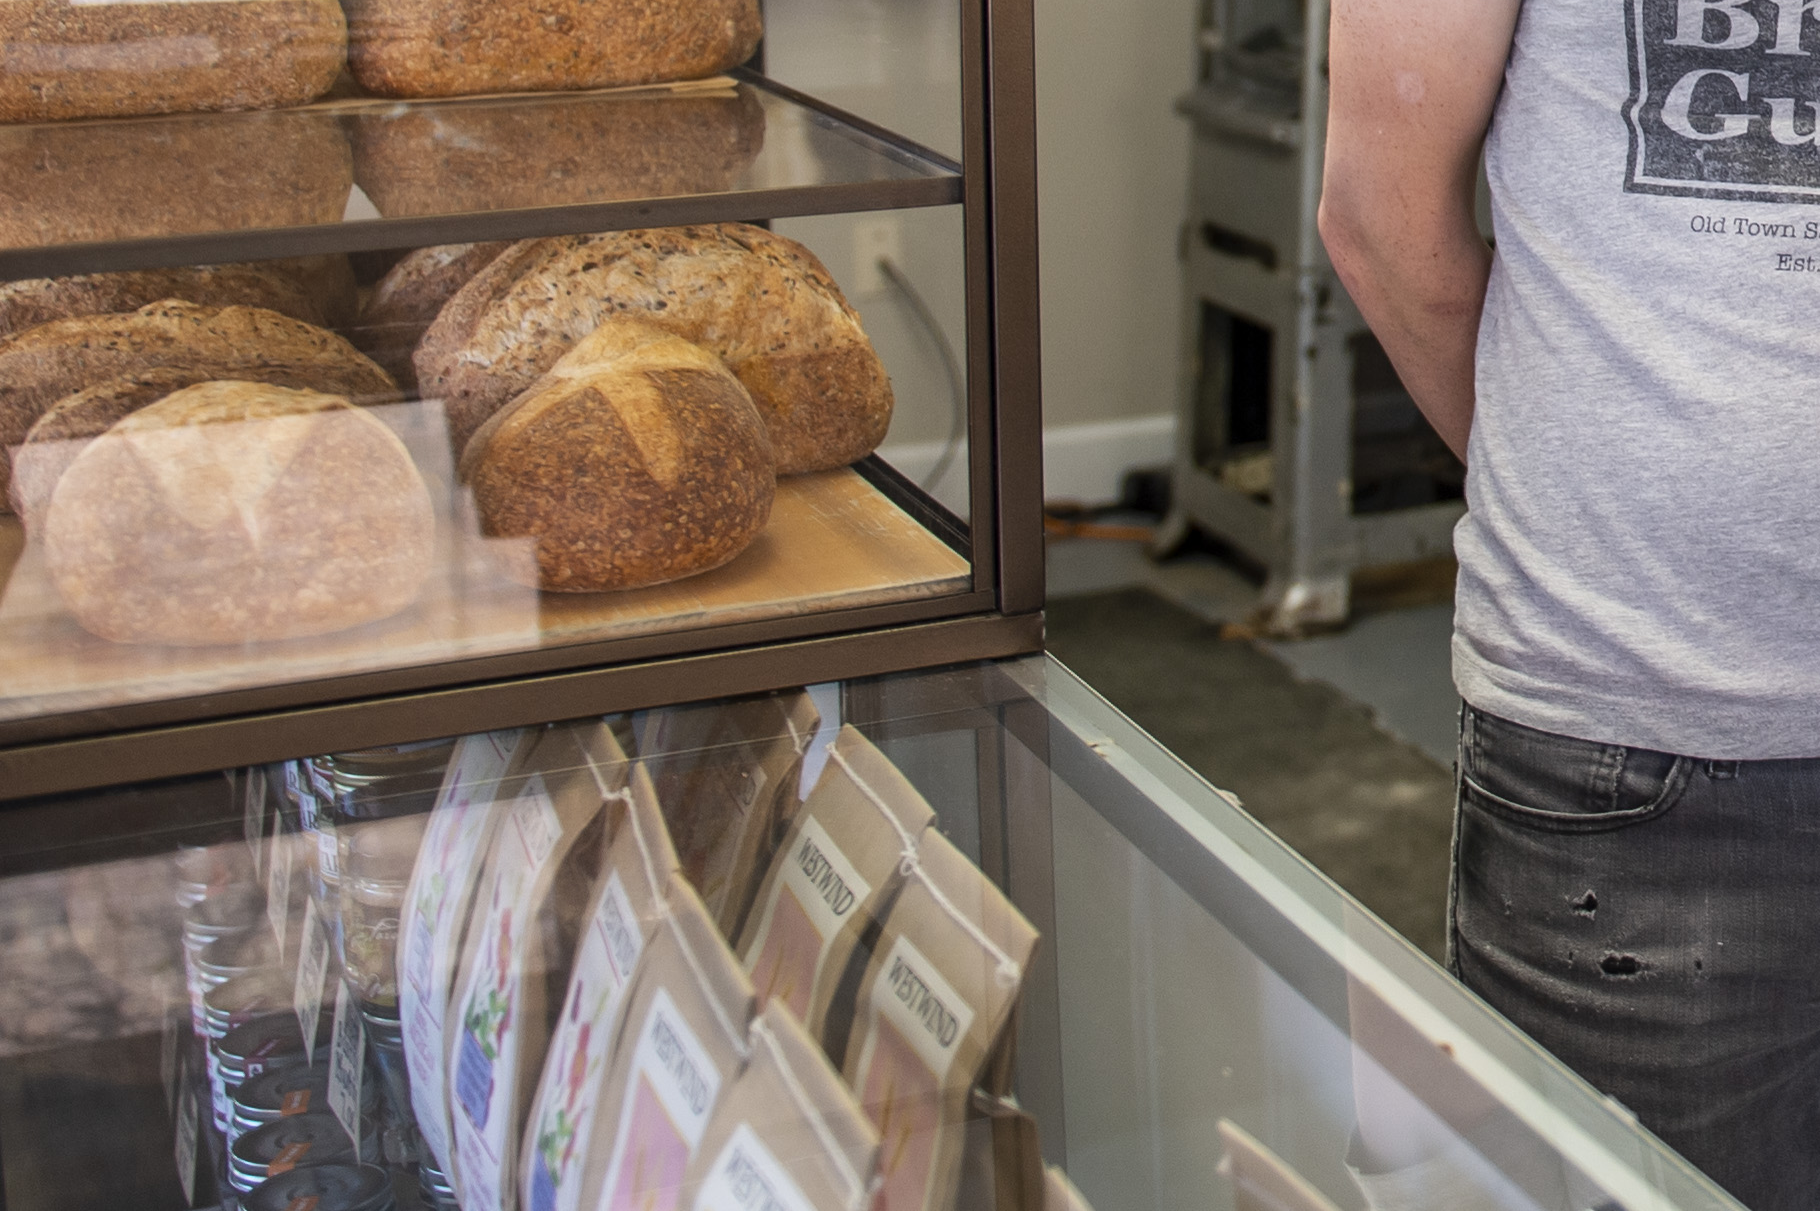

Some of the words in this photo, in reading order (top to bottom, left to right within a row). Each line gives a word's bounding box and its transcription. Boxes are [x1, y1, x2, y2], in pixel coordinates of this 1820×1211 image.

[1690, 215, 1726, 234] Old
[1733, 217, 1797, 239] Town
[798, 836, 856, 917] WESTWIND
[887, 955, 959, 1049] WESTWIND
